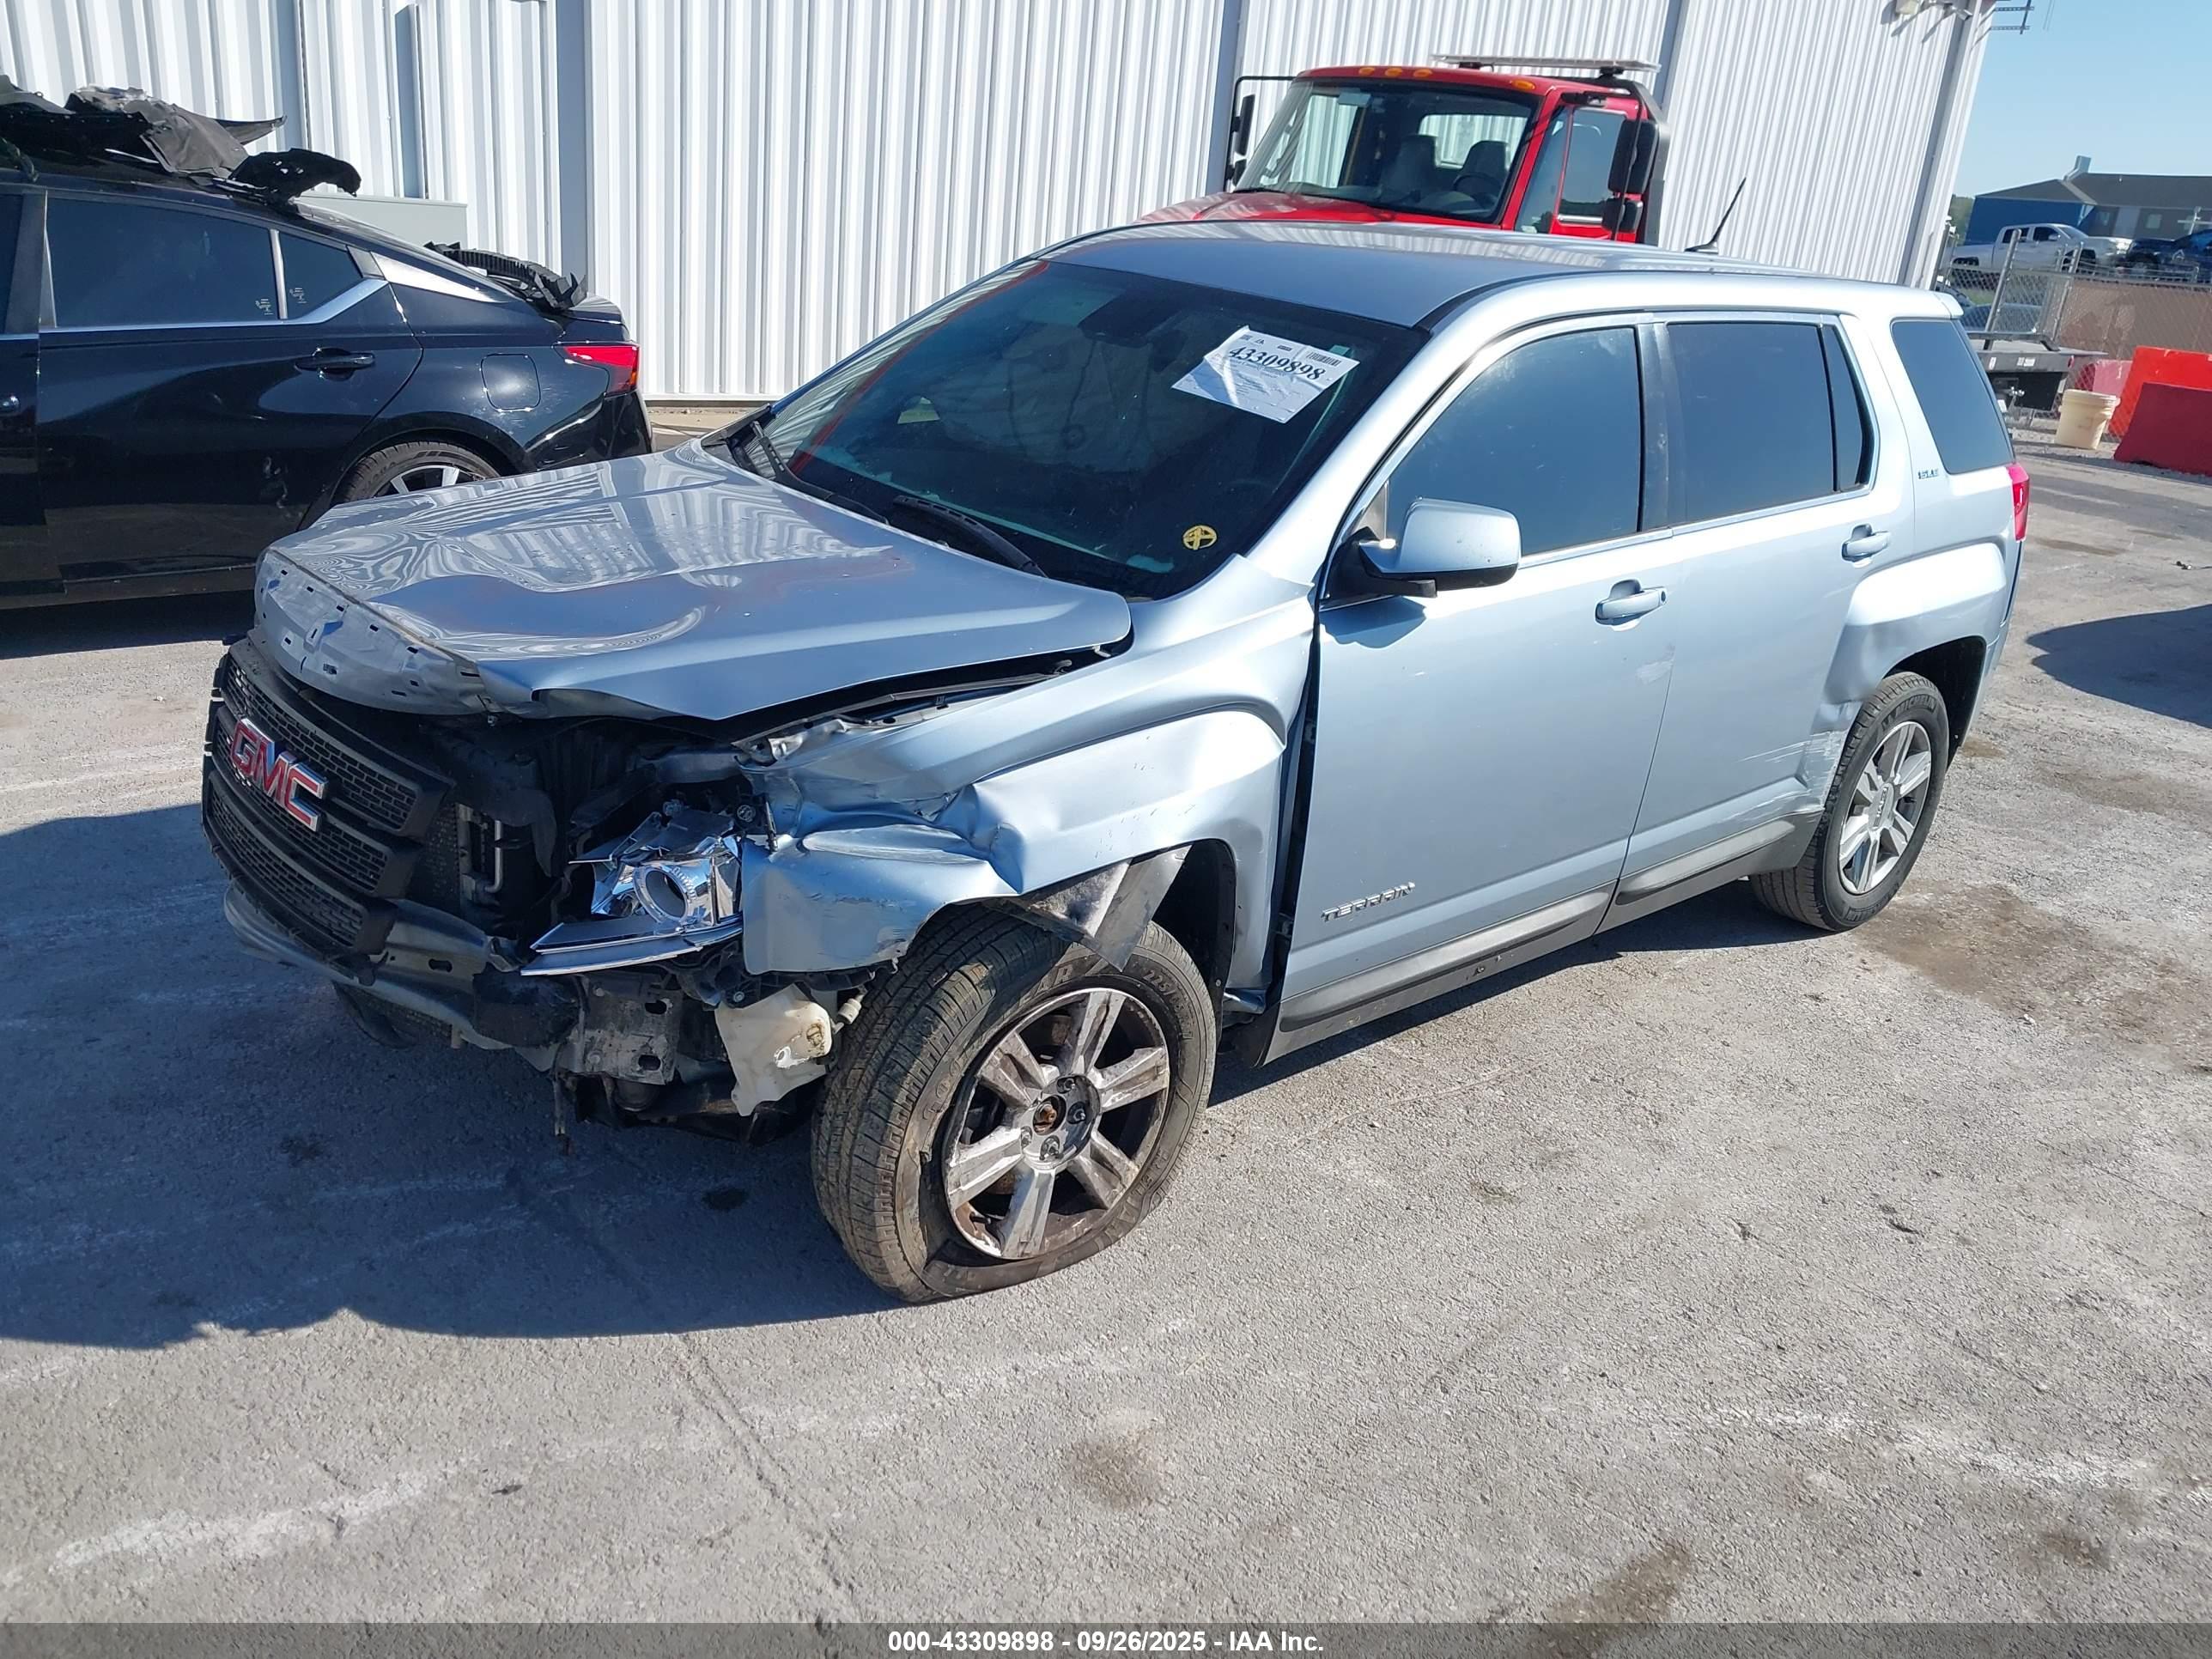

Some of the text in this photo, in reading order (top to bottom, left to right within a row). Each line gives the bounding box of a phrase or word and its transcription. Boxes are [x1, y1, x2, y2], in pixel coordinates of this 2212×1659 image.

[1229, 345, 1326, 380] 43309898
[230, 718, 327, 831] GMC
[1321, 881, 1416, 922] TERRAIN
